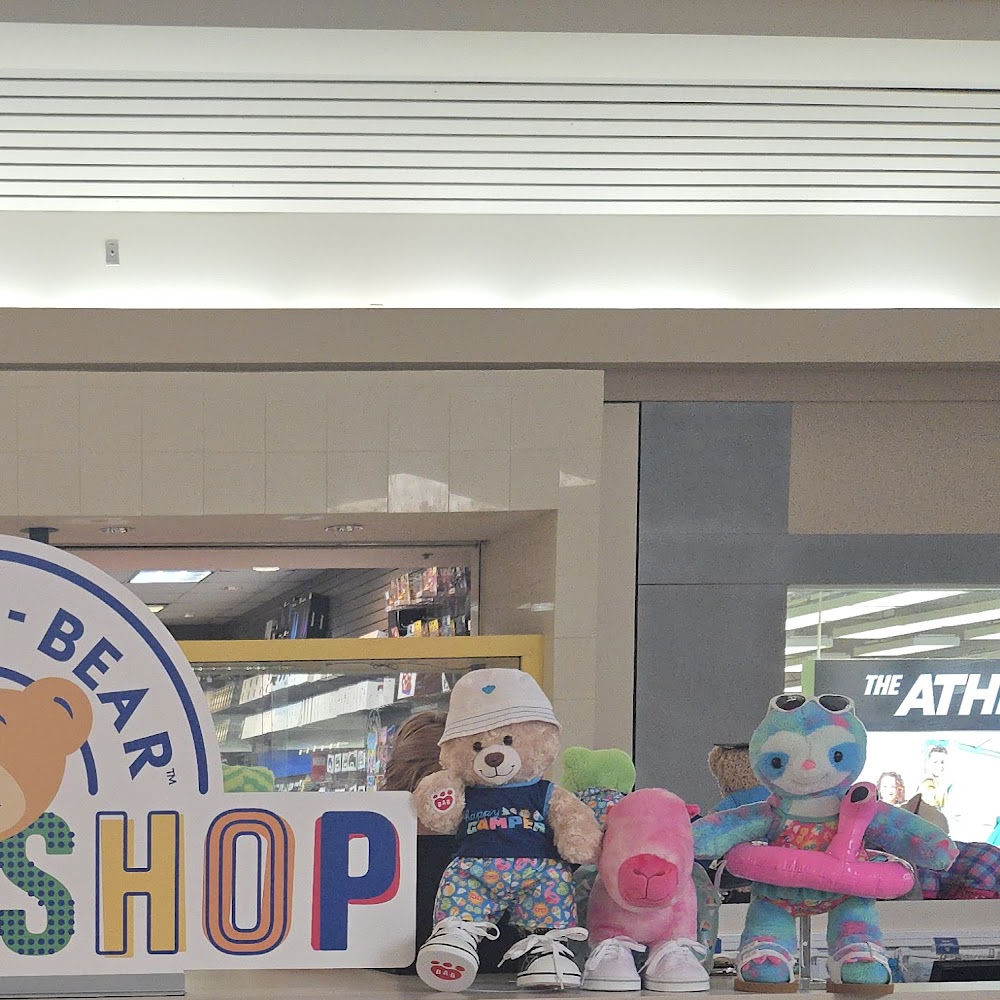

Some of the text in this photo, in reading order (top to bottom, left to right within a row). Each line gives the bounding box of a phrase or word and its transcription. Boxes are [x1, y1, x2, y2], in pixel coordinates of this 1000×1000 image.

[864, 674, 903, 695] THE
[464, 808, 500, 823] happy
[466, 816, 546, 835] CAMPER
